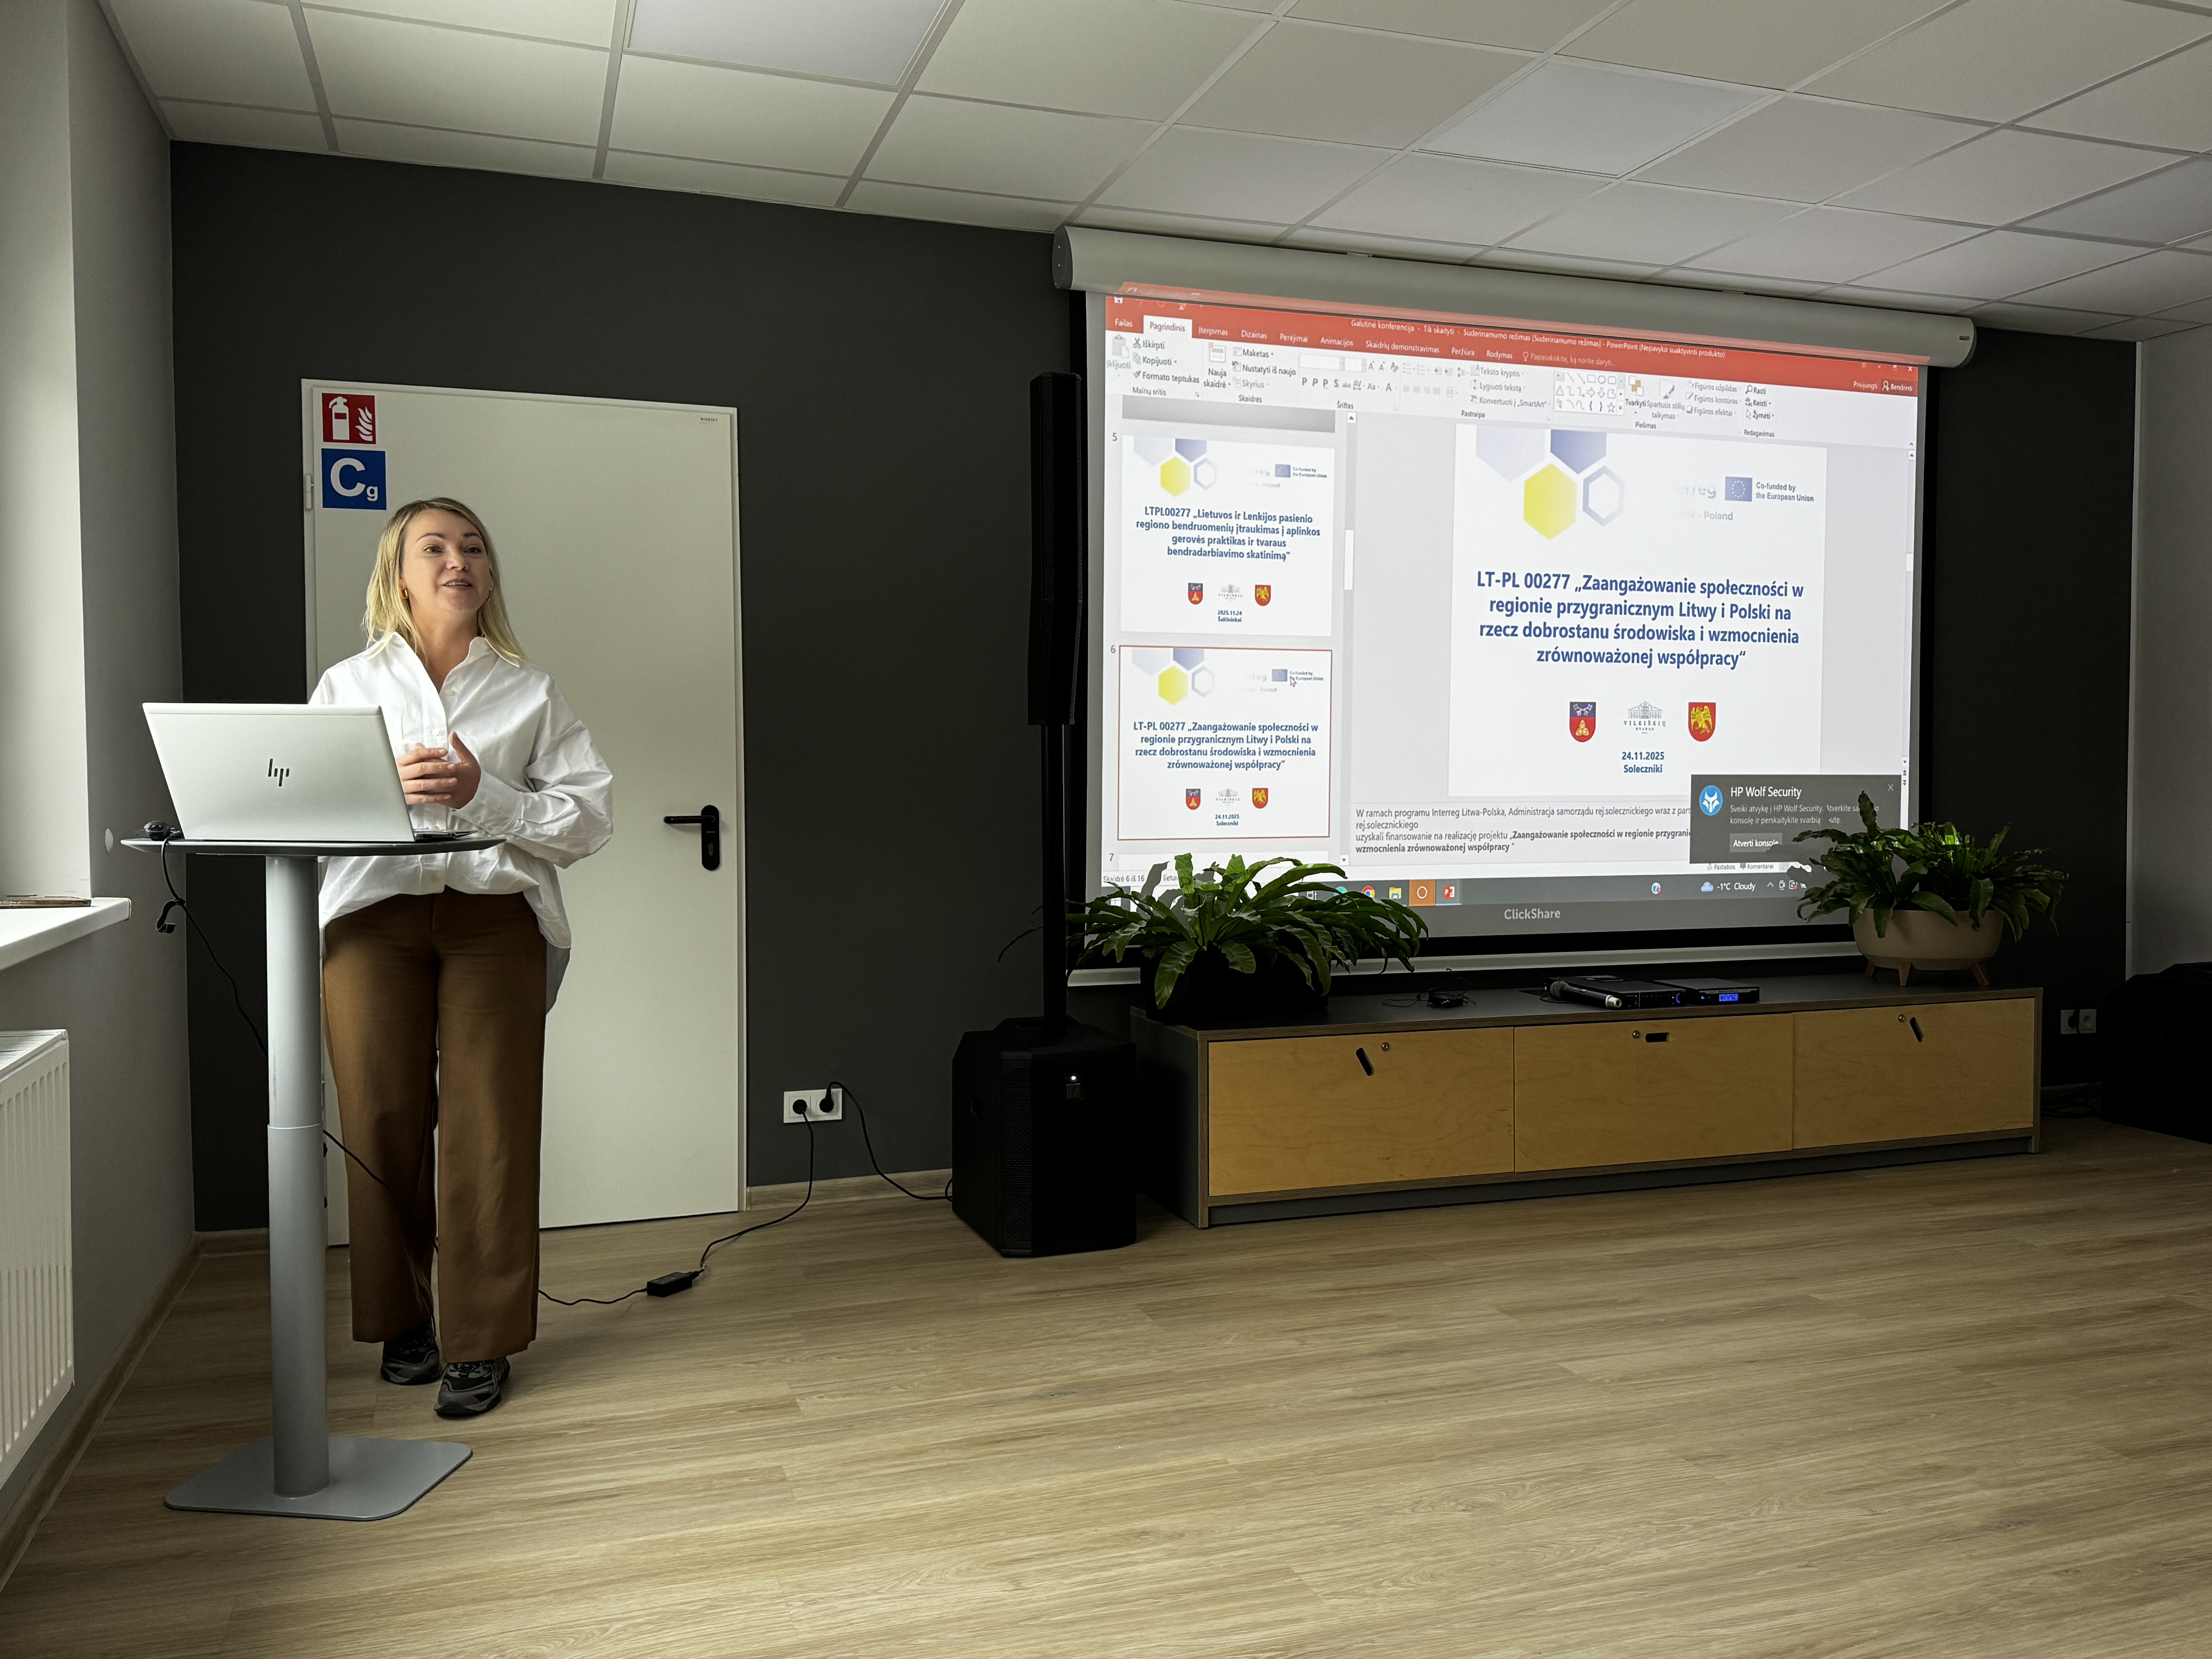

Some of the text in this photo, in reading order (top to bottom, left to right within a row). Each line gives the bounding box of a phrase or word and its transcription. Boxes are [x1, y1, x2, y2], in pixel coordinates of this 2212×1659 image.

[1115, 318, 1133, 327] Failas
[1150, 322, 1185, 332] Pagrindinis
[1199, 326, 1228, 336] Įterpimas
[1241, 330, 1267, 339] Dizainas
[1280, 333, 1308, 343] Perėjimai
[1321, 337, 1353, 347] Animacijos
[1391, 342, 1439, 353] demonstravimas
[1487, 350, 1512, 359] Rodymas
[1143, 340, 1164, 350] Iškirpti
[1243, 349, 1269, 358] Maketas
[1143, 356, 1171, 366] Kopijuoti
[1208, 368, 1226, 378] Nauja
[1242, 365, 1270, 375] Nustatyti
[1279, 369, 1296, 377] naujo
[1143, 372, 1199, 384] Formato teptukas
[1204, 380, 1226, 388] skaidrė
[1238, 395, 1262, 403] Skaidrės
[1462, 410, 1485, 419] Pastraipa
[1113, 433, 1117, 441] 5
[1756, 482, 1796, 492] Co-funded by
[1145, 506, 1313, 524] LTPL00277 „Lietuvos ir Lenkijos pasienio
[1704, 512, 1733, 520] Poland
[1136, 520, 1320, 537] regiono bendruomenių įtraukimas į aplinkos
[1172, 535, 1286, 547] gerovės praktikas ir tvaraus
[1168, 546, 1290, 562] bendradarbiavimo skatinimą“
[1477, 571, 1803, 598] LT-PL 00277 „Zaangażowanie społeczności w
[1490, 596, 1791, 622] regionie przygranicznym Litwy i Polski na
[1480, 622, 1799, 643] rzecz dobrostanu środowiska i wzmocnienia
[1111, 645, 1115, 653] 6
[1537, 646, 1746, 670] zrównoważonej współpracy“
[1134, 721, 1158, 730] LT-PL
[1159, 722, 1185, 730] 00277
[1188, 722, 1256, 733] „Zaangażowanie
[1258, 723, 1309, 733] społeczności
[1141, 734, 1176, 745] regionie
[1178, 735, 1244, 746] przygranicznym
[1247, 735, 1268, 746] Litwy
[1270, 735, 1273, 744] i
[1275, 735, 1299, 744] Polski
[1159, 747, 1207, 756] dobrostanu
[1210, 747, 1256, 756] środowiska
[1259, 747, 1261, 756] i
[1263, 747, 1316, 756] wzmocnienia
[1622, 752, 1664, 760] 24.11.2025
[1167, 759, 1285, 771] zrównoważonej współpracy“
[1624, 764, 1662, 773] Soleczniki
[1731, 786, 1802, 799] HP Wolf Security
[1356, 809, 1364, 817] W
[1366, 808, 1392, 817] ramach
[1395, 811, 1430, 819] programu
[1432, 809, 1460, 819] Interreg
[1462, 807, 1506, 817] Litwa-Polska,
[1508, 807, 1554, 817] Administracja
[1556, 807, 1594, 817] samorządu
[1595, 806, 1653, 817] rej.solecznickiego
[1356, 819, 1419, 831] rej.solecznickiego
[1356, 831, 1383, 843] uzyskali
[1386, 830, 1432, 840] finansowanie
[1445, 831, 1477, 842] realizację
[1479, 831, 1508, 842] projektu
[1510, 830, 1568, 841] „Zaangażowanie
[1570, 829, 1615, 840] społeczności
[1625, 829, 1654, 840] regionie
[1356, 842, 1510, 854] wzmocnienia zrównoważonej współpracy
[1733, 839, 1754, 847] Atverti
[1109, 853, 1114, 861] 7
[1717, 882, 1755, 891] -1°C Cloudy
[1504, 908, 1561, 920] ClickShare
